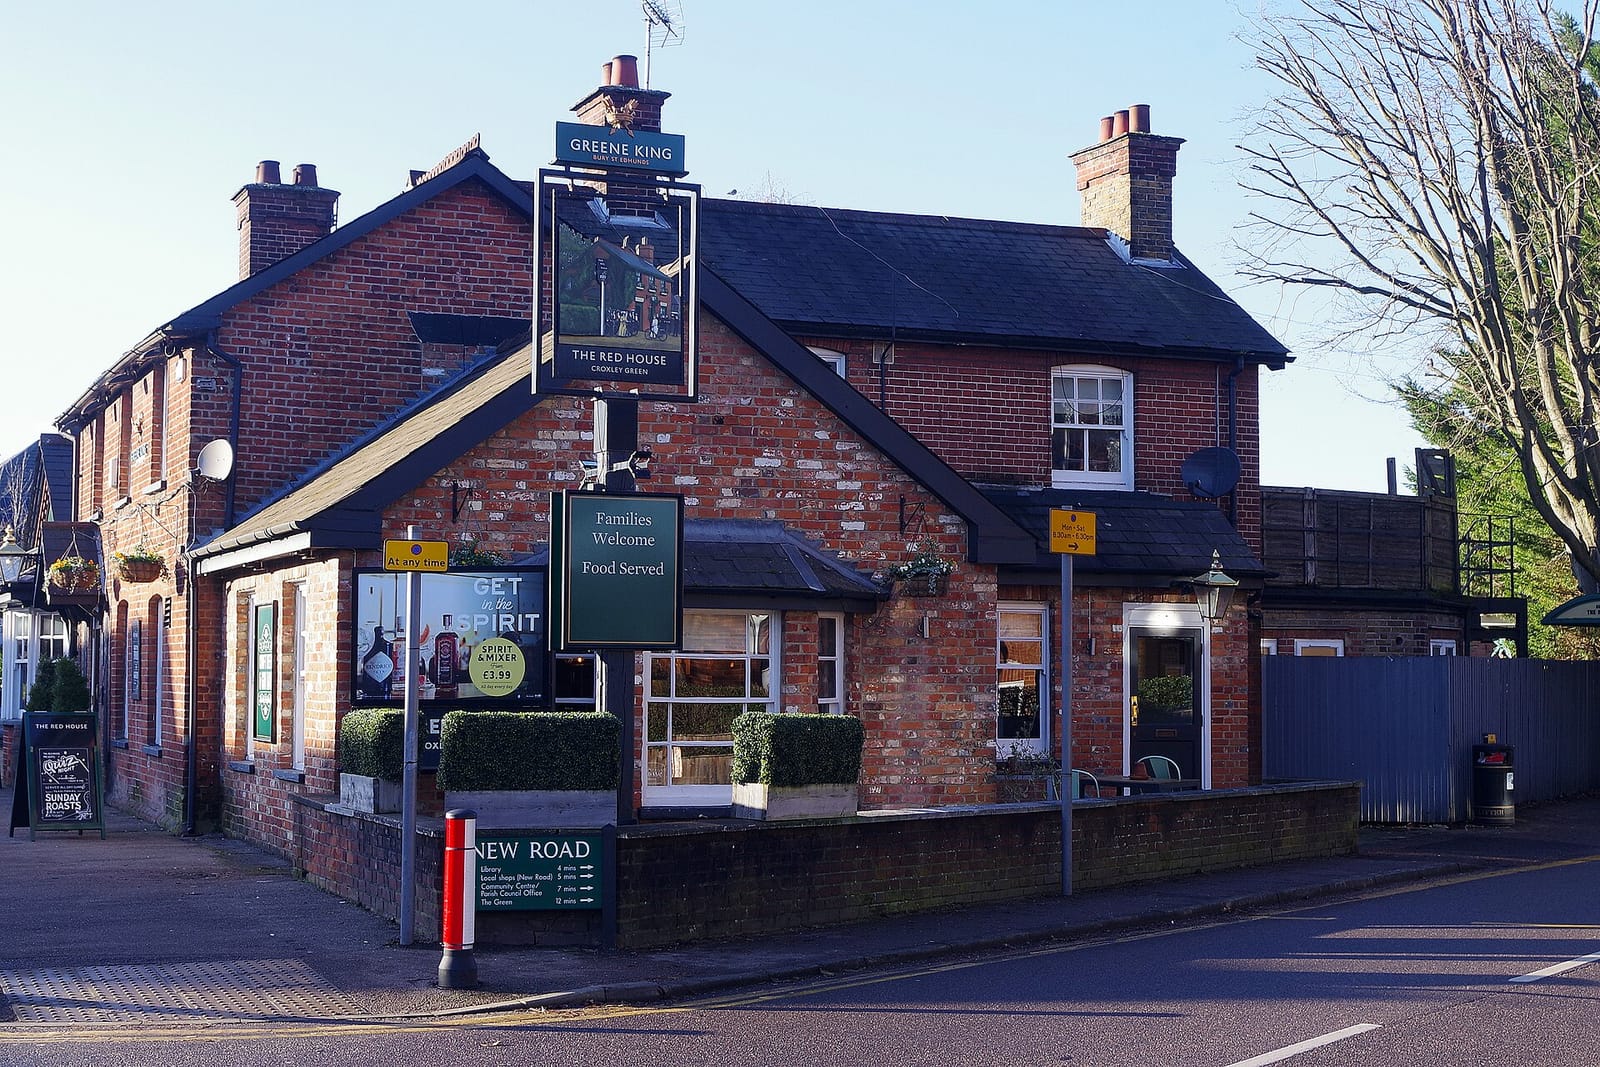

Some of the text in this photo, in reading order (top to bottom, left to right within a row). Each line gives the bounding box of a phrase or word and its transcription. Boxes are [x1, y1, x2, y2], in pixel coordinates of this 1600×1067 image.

[570, 138, 672, 160] GREENE KING
[620, 157, 649, 166] EDMUNDS
[572, 349, 667, 366] THE RED HOUSE
[591, 365, 648, 375] CROXLEY GREEN
[595, 511, 652, 526] Families
[592, 531, 656, 547] Welcome
[387, 557, 446, 568] At any time
[582, 560, 665, 576] Food Served
[473, 577, 523, 596] GET
[481, 596, 514, 611] in the
[456, 613, 540, 632] SPIRIT
[482, 645, 513, 654] SPIRIT
[477, 653, 517, 662] & MIXER
[483, 670, 511, 680] £3.99
[44, 757, 79, 773] Quiz
[45, 793, 81, 801] SUNDAY
[46, 801, 81, 811] ROASTS
[475, 841, 590, 859] NEW ROAD
[480, 866, 501, 874] Library
[515, 882, 540, 890] Centre/
